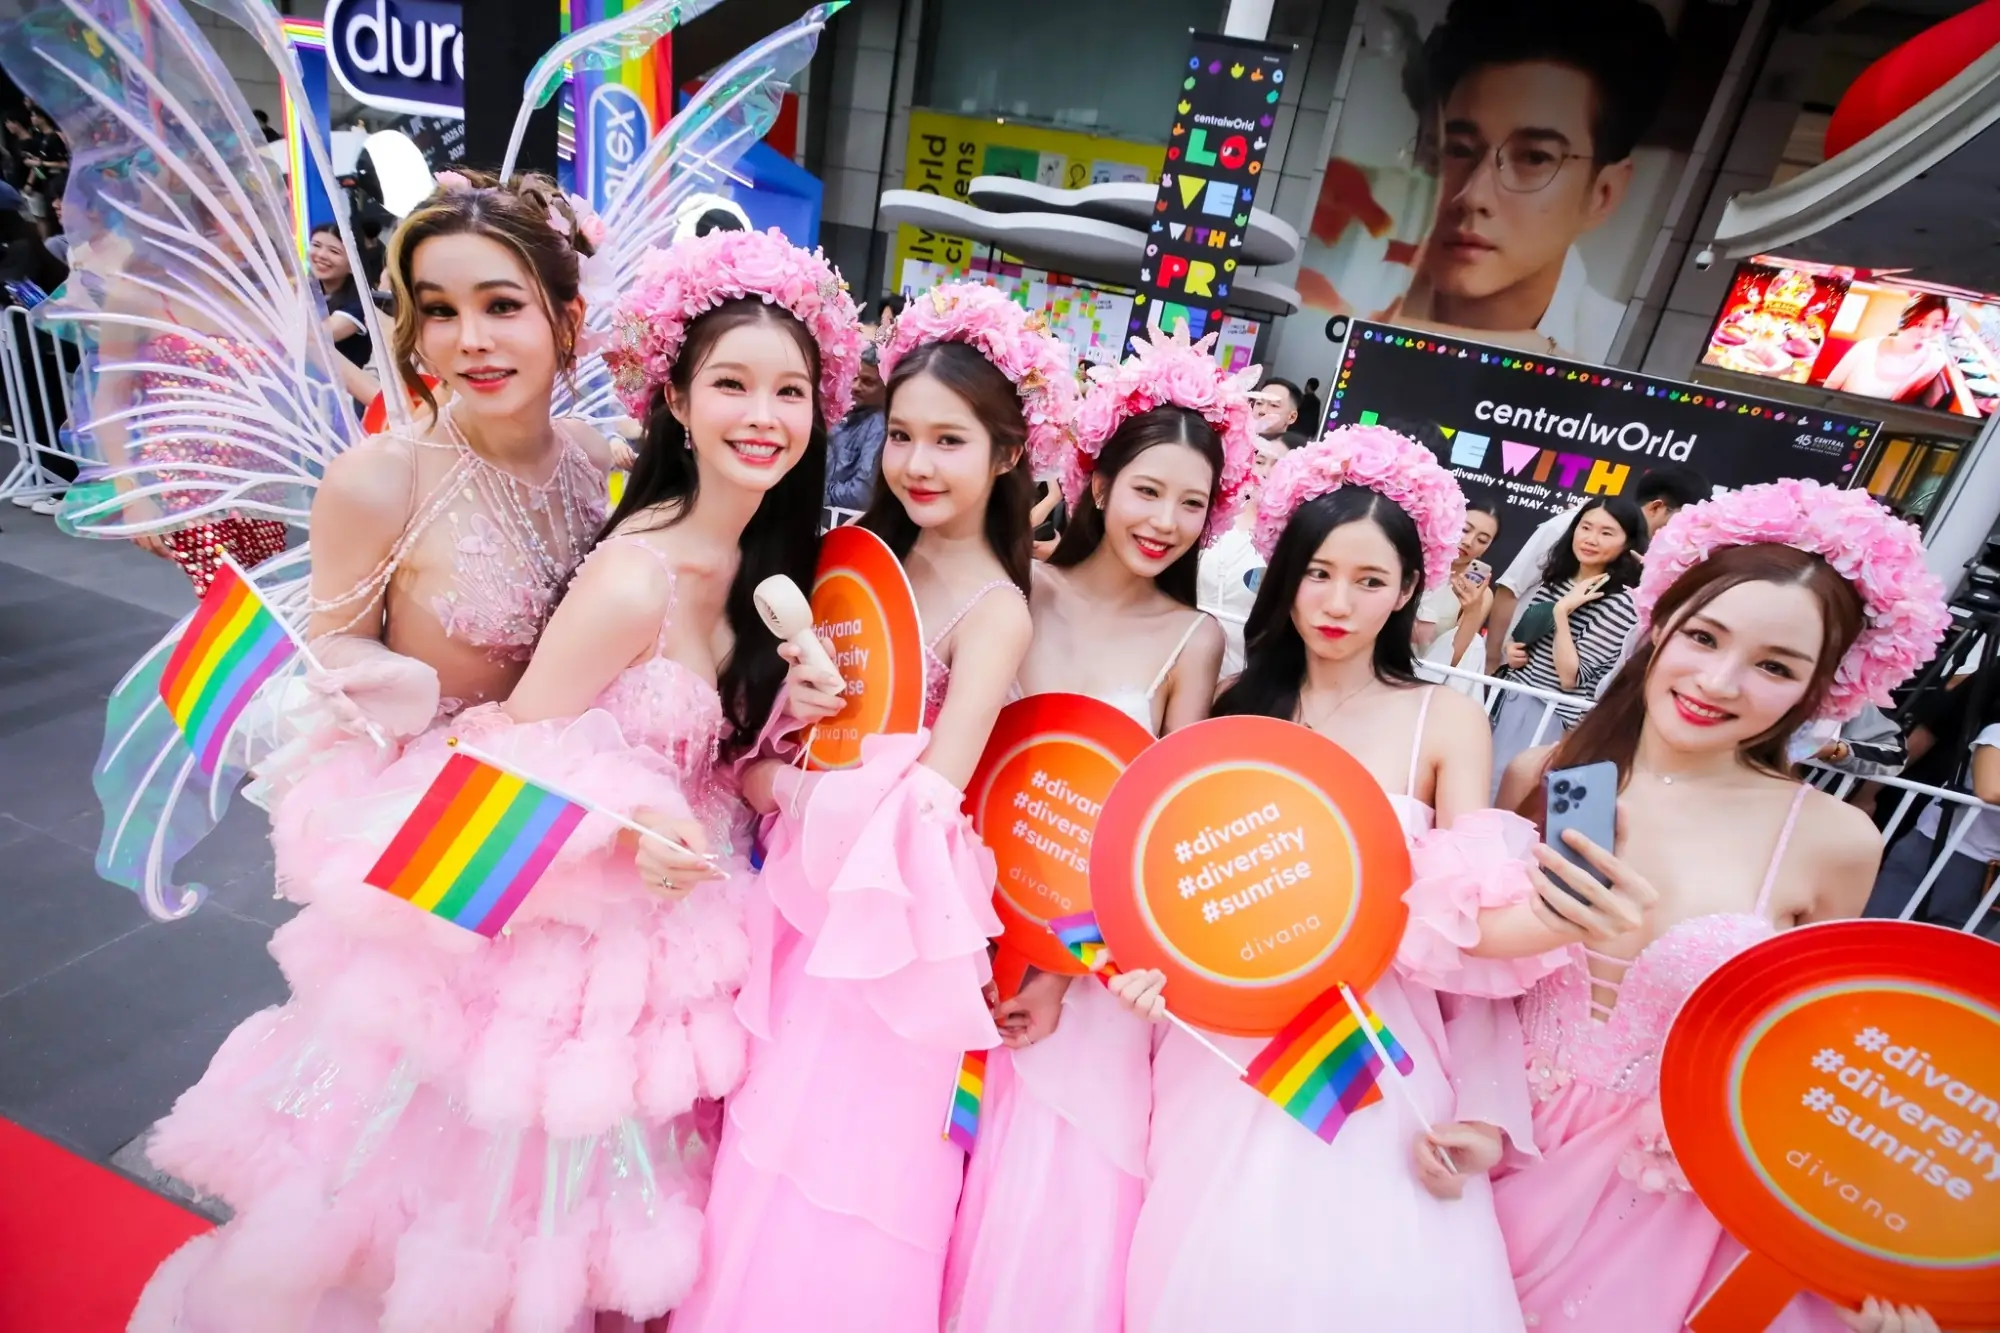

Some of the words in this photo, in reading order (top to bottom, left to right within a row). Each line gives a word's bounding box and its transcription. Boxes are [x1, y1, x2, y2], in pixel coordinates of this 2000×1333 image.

[1194, 114, 1255, 132] centralwOrld
[1185, 128, 1248, 169] LO
[1178, 174, 1239, 218] VE
[1169, 222, 1227, 249] WITH
[1156, 253, 1216, 298] PR
[1474, 400, 1698, 463] centralwOrld
[1795, 434, 1813, 446] 45
[1814, 436, 1845, 448] CENTRAL
[1452, 467, 1496, 487] diversity
[1505, 480, 1552, 499] equality
[1501, 440, 1631, 496] WITH
[1506, 494, 1517, 504] 31
[1519, 497, 1543, 510] MAY
[1550, 504, 1564, 514] 30
[1011, 819, 1090, 875] #sunris
[1174, 802, 1281, 864] #divana
[1177, 826, 1306, 899] #diversity
[1008, 865, 1073, 911] divana
[1201, 860, 1312, 924] #sunrise
[1240, 914, 1321, 962] divana
[1854, 1026, 2000, 1129] #divan
[1801, 1086, 1974, 1201] #sunrise
[1785, 1149, 1909, 1233] divana
